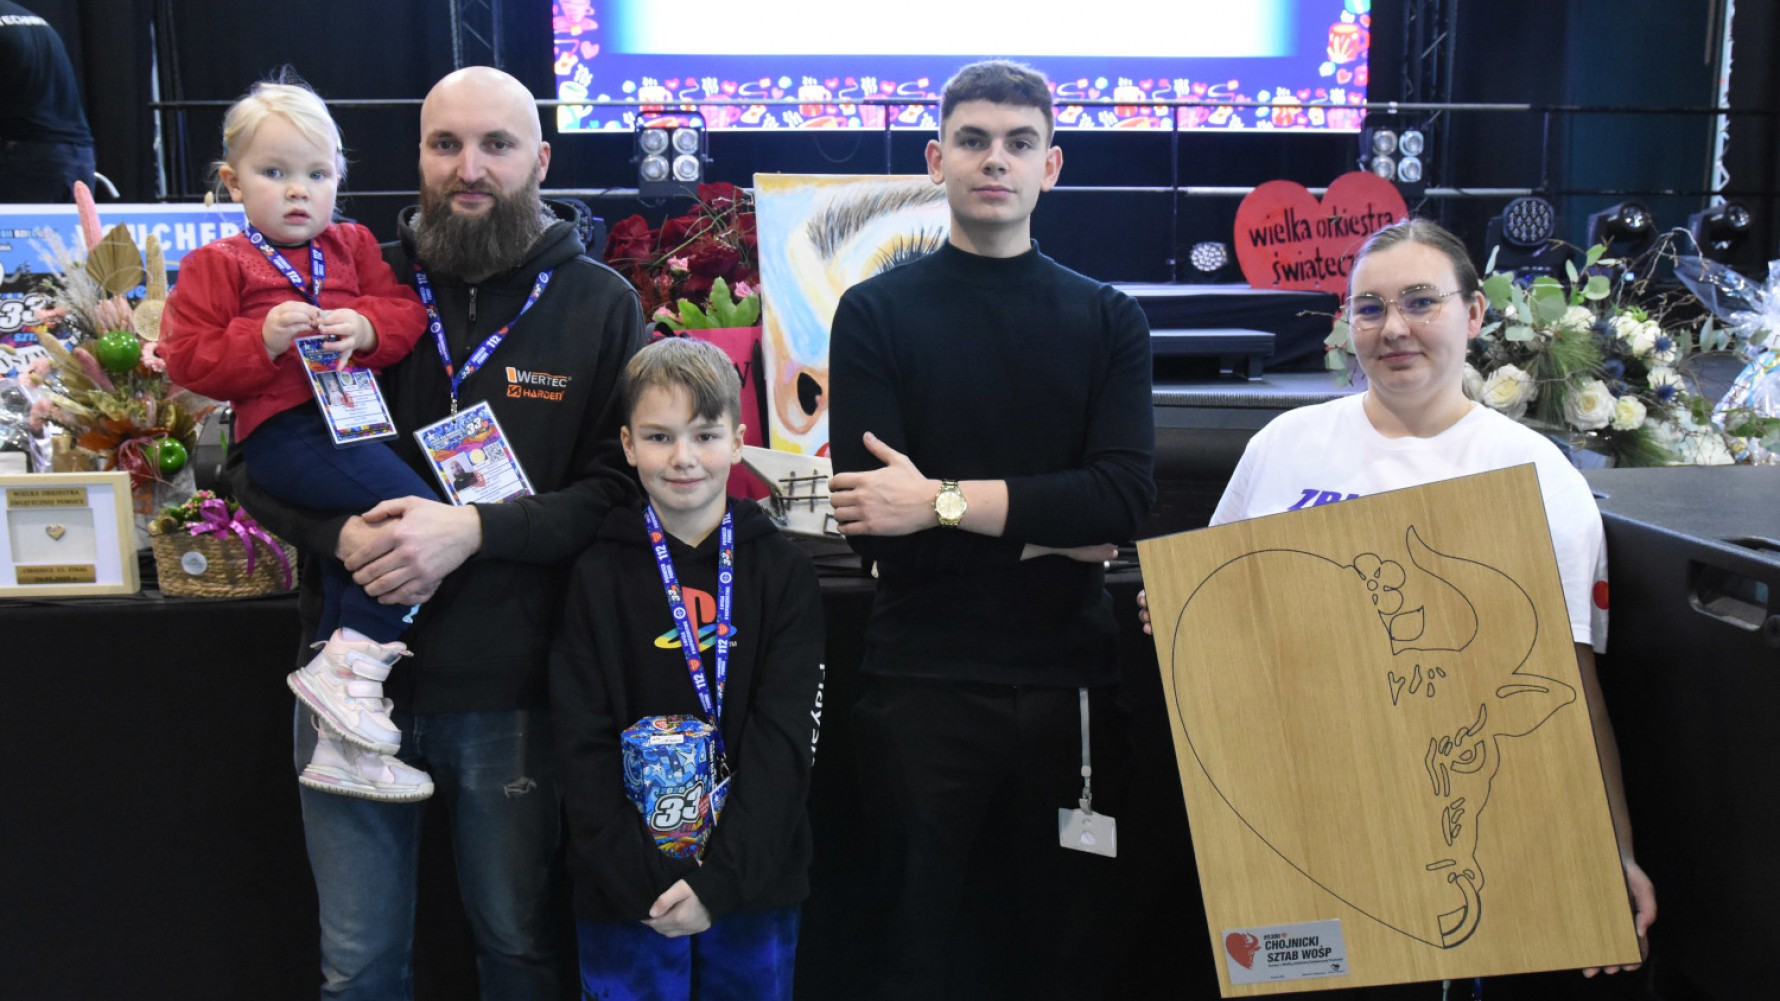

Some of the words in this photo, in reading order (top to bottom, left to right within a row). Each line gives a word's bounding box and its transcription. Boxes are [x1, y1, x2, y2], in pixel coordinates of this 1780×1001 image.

[1249, 207, 1312, 247] wielka
[1316, 203, 1393, 238] orkiestra
[486, 335, 502, 348] 112
[517, 370, 568, 388] WERTEC
[655, 544, 669, 561] 112
[718, 639, 729, 655] 112
[693, 672, 706, 690] 112
[652, 782, 703, 830] 33
[1265, 936, 1319, 950] CHOJNICKI
[1267, 950, 1299, 963] SZTAB
[1301, 945, 1332, 960] WOŚP
